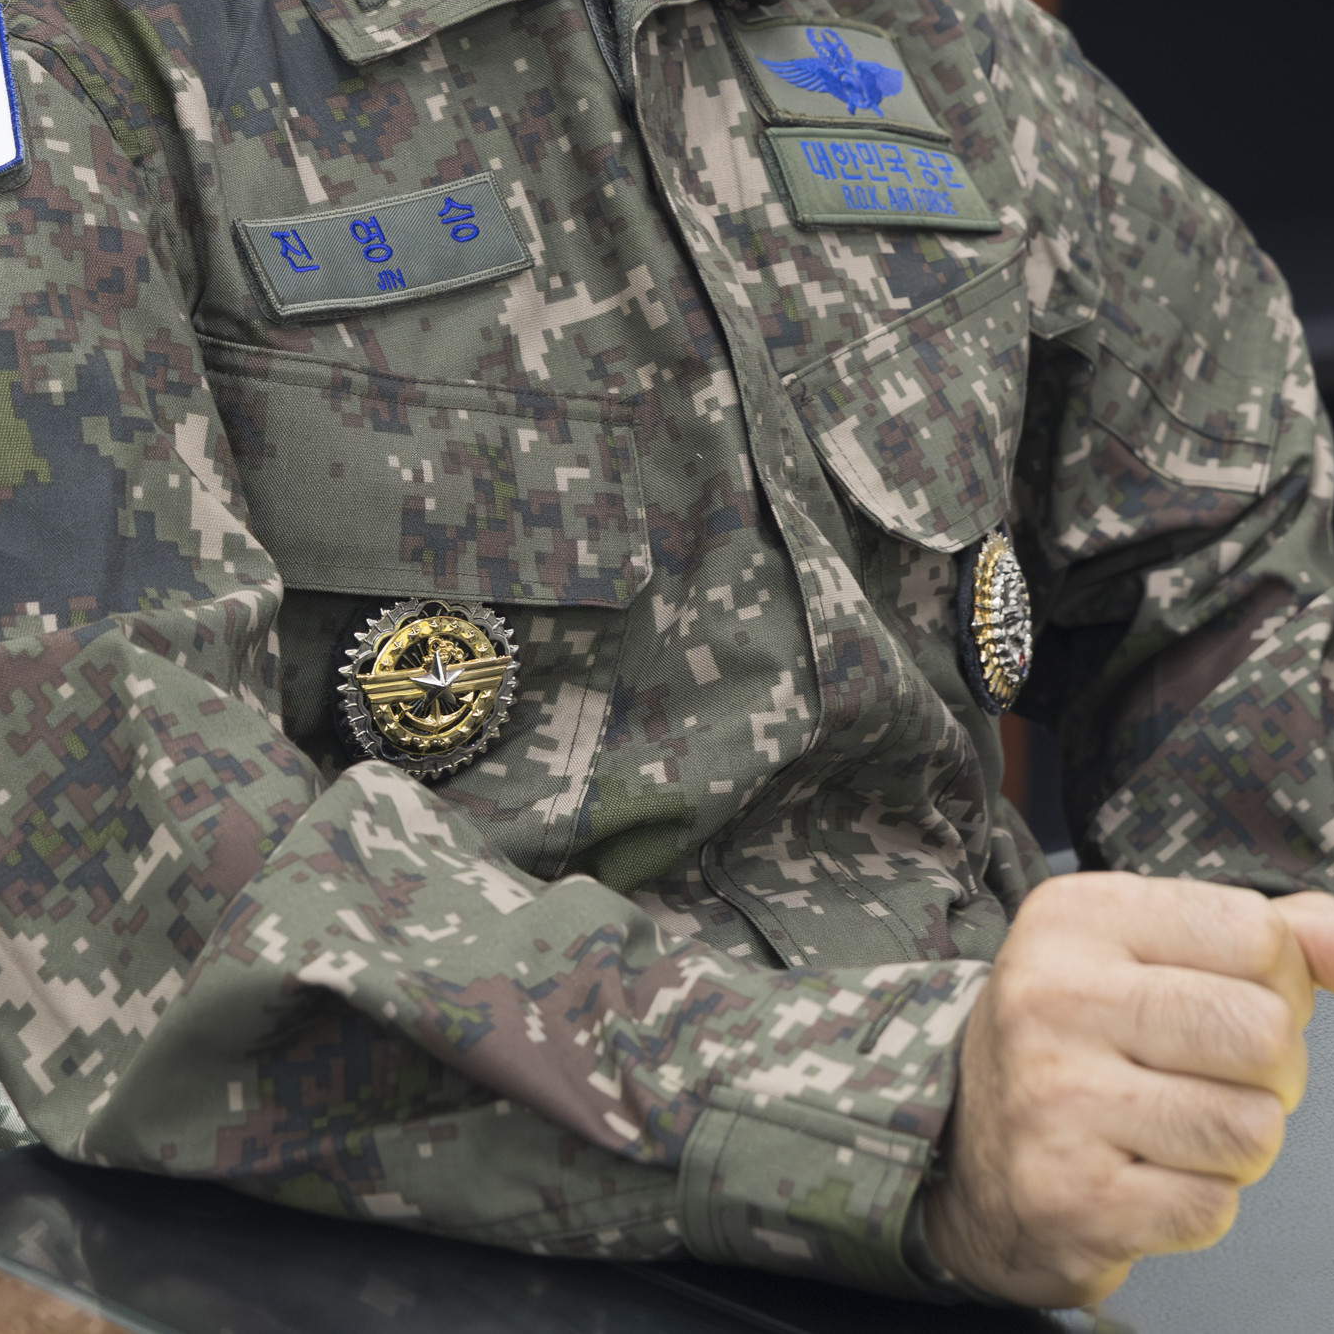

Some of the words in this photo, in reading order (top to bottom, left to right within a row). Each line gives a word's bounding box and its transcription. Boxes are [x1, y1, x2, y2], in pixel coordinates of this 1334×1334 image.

[800, 141, 913, 183] 대한민국
[909, 148, 964, 188] 공군
[887, 186, 914, 211] AIR
[377, 268, 406, 290] JIN
